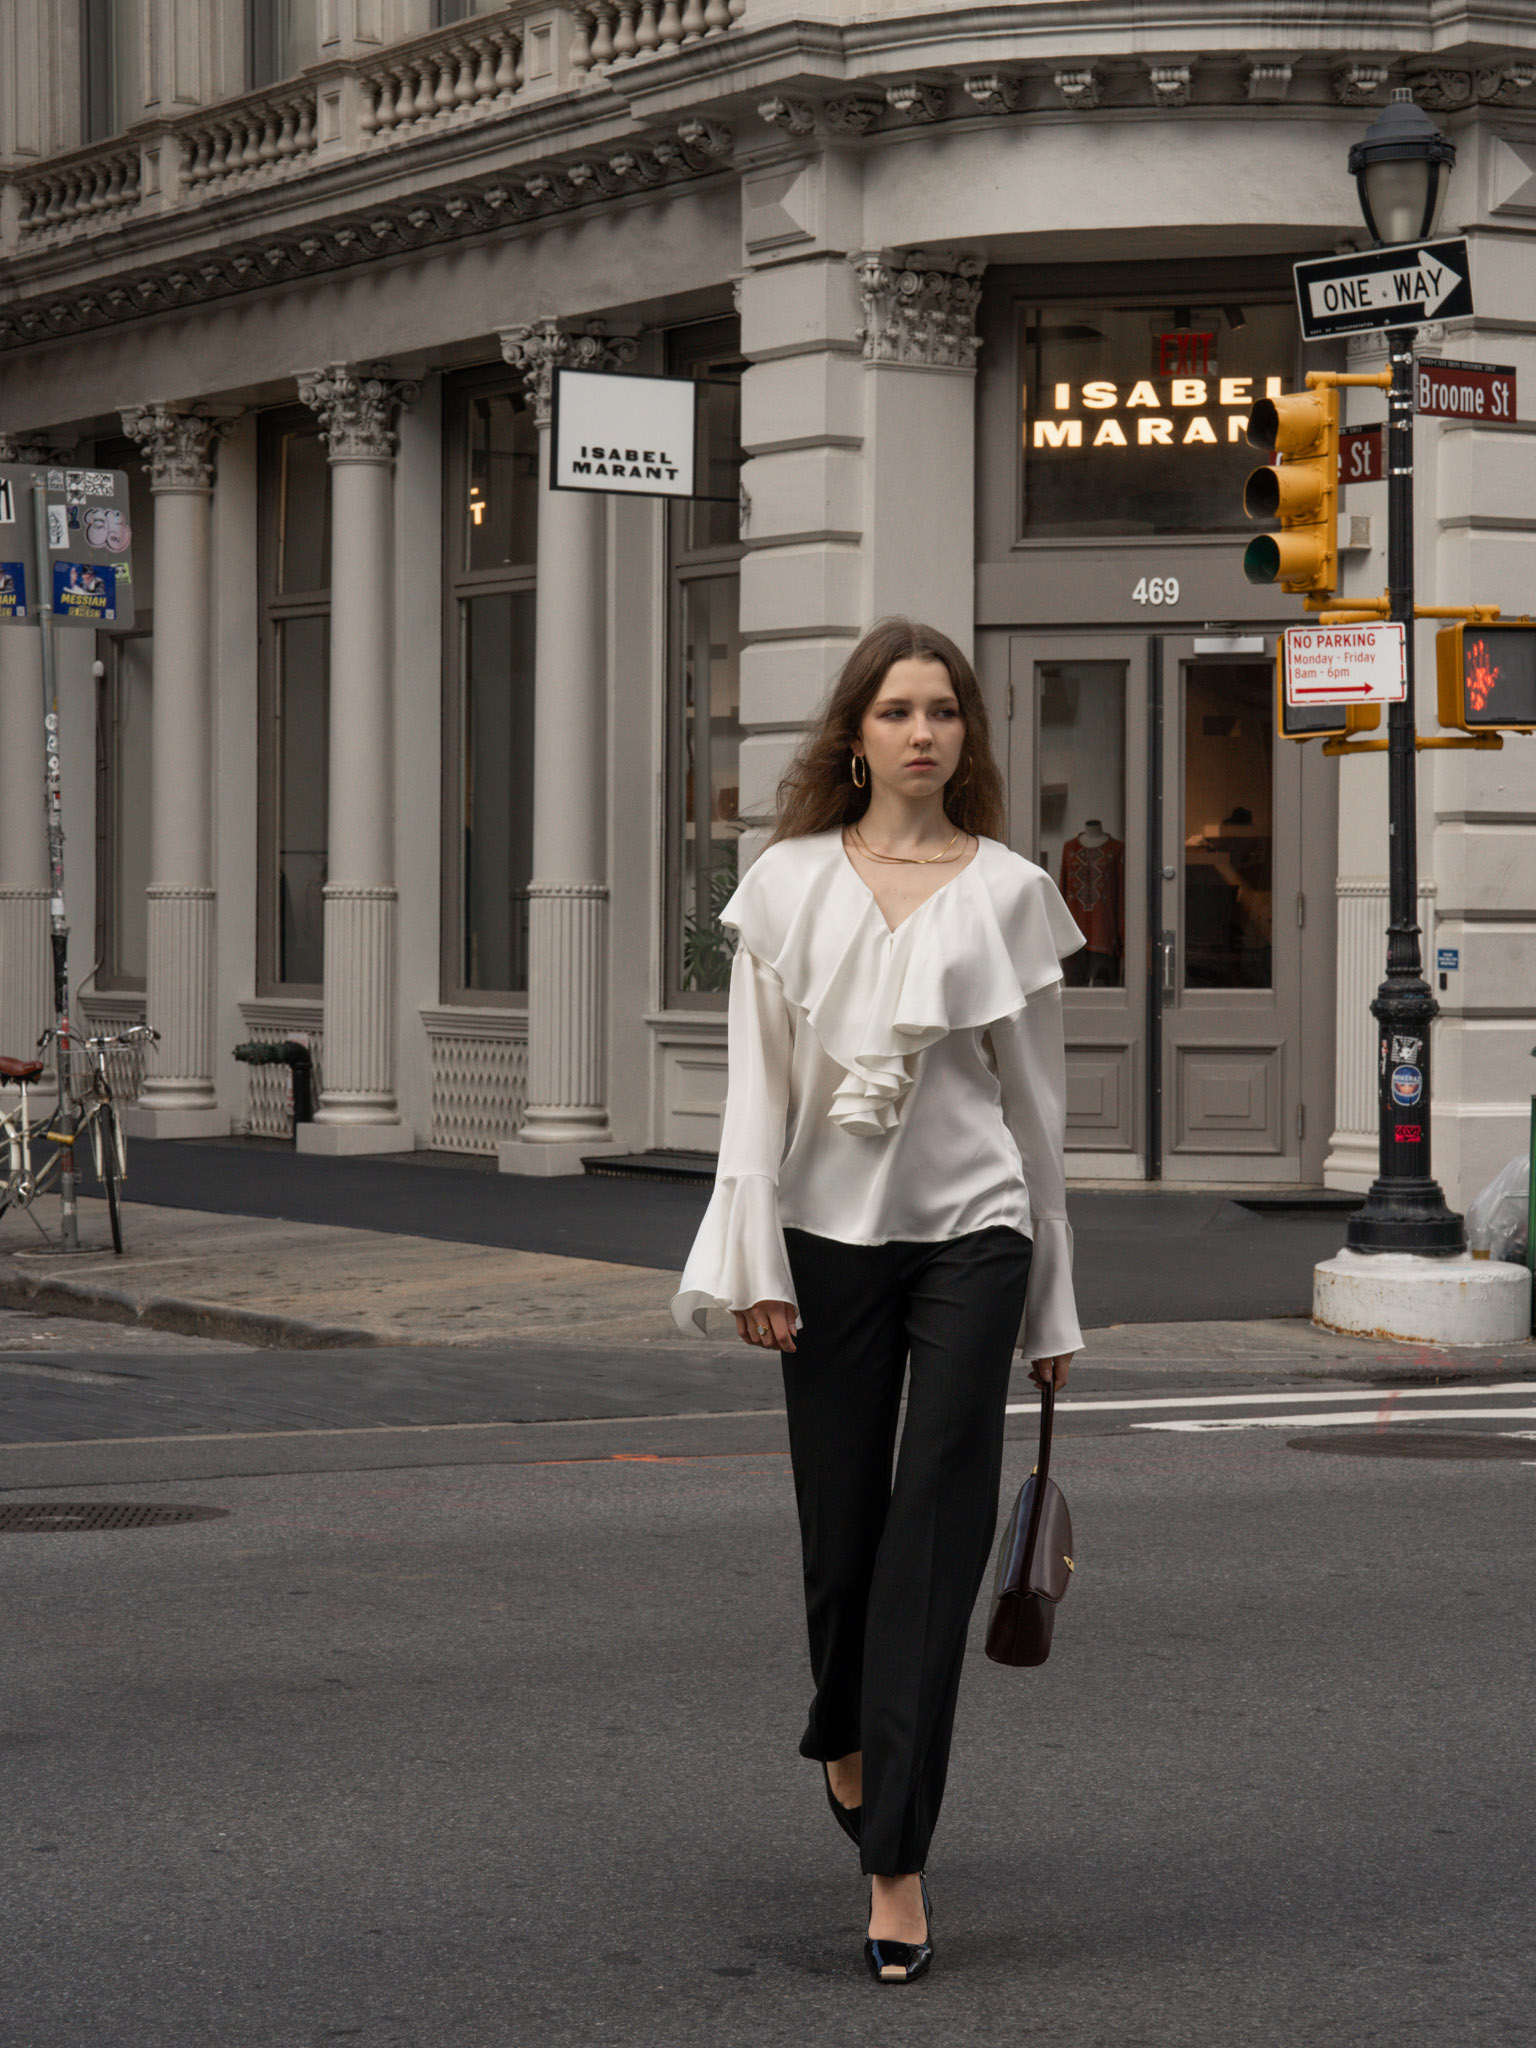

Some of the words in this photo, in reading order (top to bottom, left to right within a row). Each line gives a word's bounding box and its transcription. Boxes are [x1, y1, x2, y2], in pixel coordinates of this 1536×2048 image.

[1323, 279, 1372, 312] ONE
[1393, 267, 1443, 302] WAY
[1160, 333, 1213, 376] EXIT
[1419, 373, 1485, 414] Broome
[1491, 380, 1510, 417] St
[1033, 415, 1250, 447] MARAN
[581, 446, 672, 465] ISABEL
[1351, 440, 1371, 477] St
[572, 461, 679, 480] MARANT
[61, 593, 107, 607] MESSIAH
[1132, 577, 1180, 605] 469
[1293, 635, 1312, 649] NO
[1317, 633, 1376, 648] PARKING
[1294, 653, 1334, 665] Monday
[1344, 652, 1376, 663] Friday
[1294, 668, 1317, 679] 8am
[1327, 667, 1350, 680] 6pm
